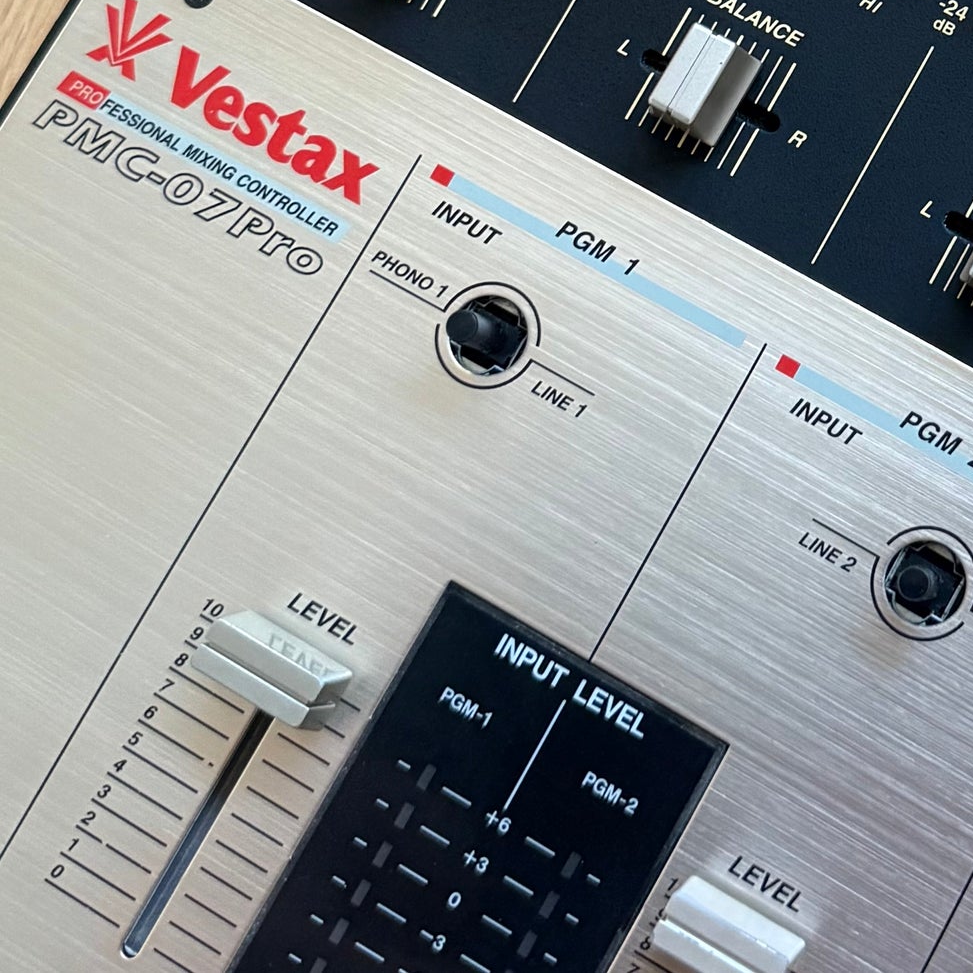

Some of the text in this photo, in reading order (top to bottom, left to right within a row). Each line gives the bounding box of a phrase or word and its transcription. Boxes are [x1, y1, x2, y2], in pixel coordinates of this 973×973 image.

[933, 16, 956, 37] dB
[617, 39, 632, 57] L
[170, 44, 380, 206] Vestax
[787, 130, 809, 148] R
[69, 79, 340, 237] PROFESSIONAL MIXING CONTROLLER
[32, 99, 324, 276] PMC-07Pro
[919, 200, 933, 219] L
[432, 201, 503, 246] INPUT
[555, 221, 641, 276] PGM 1
[370, 250, 450, 298] PHONO 1
[531, 380, 588, 418] LINE 1
[789, 398, 863, 445] INPUT
[900, 411, 963, 455] PGM
[798, 532, 858, 572] LINE 2
[201, 597, 225, 618] 10
[287, 592, 359, 645] LEVEL
[190, 626, 204, 640] 9
[174, 652, 189, 667] 8
[158, 678, 175, 692] 7
[494, 633, 645, 739] INPUT LEVEL
[143, 705, 158, 719] 6
[439, 687, 493, 728] PGM-1
[128, 731, 143, 746] 5
[112, 758, 127, 772] 4
[97, 784, 111, 799] 3
[582, 771, 640, 816] PGM-2
[81, 811, 96, 826] 2
[486, 810, 512, 833] +6
[67, 838, 80, 852] 1
[50, 864, 65, 879] 0
[463, 849, 490, 874] +3
[728, 855, 805, 914] LEVEL
[447, 891, 462, 909] 0
[419, 929, 446, 953] -3
